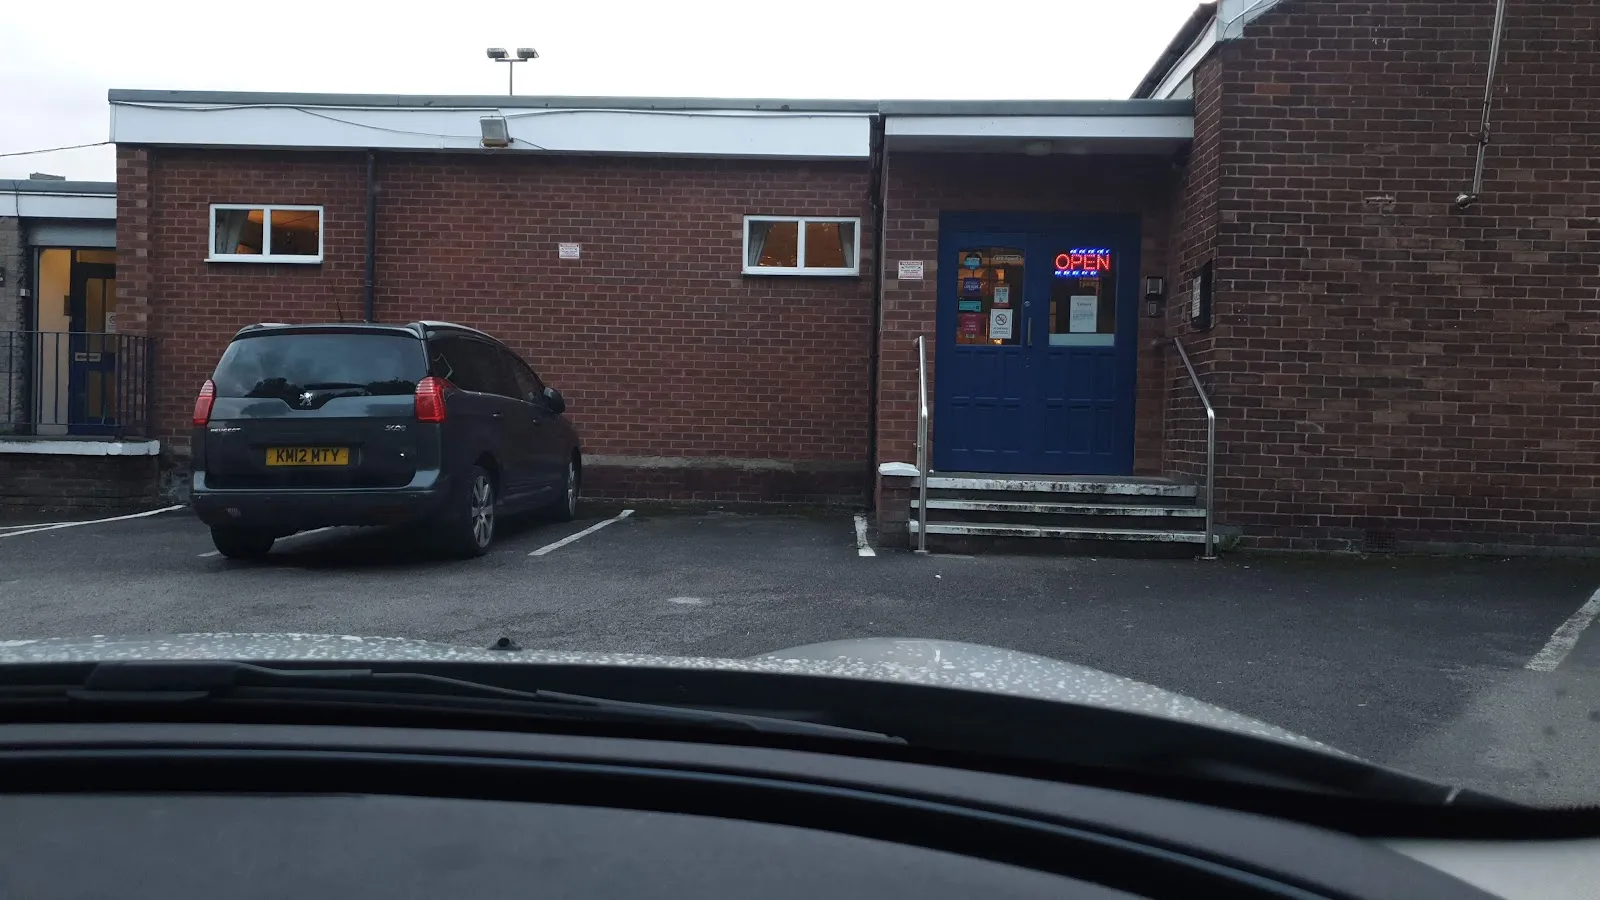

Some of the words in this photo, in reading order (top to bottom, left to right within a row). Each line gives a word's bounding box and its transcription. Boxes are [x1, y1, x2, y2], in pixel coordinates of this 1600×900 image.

[1055, 253, 1110, 270] OPEN
[276, 448, 308, 463] KM12
[311, 448, 340, 462] MTY
